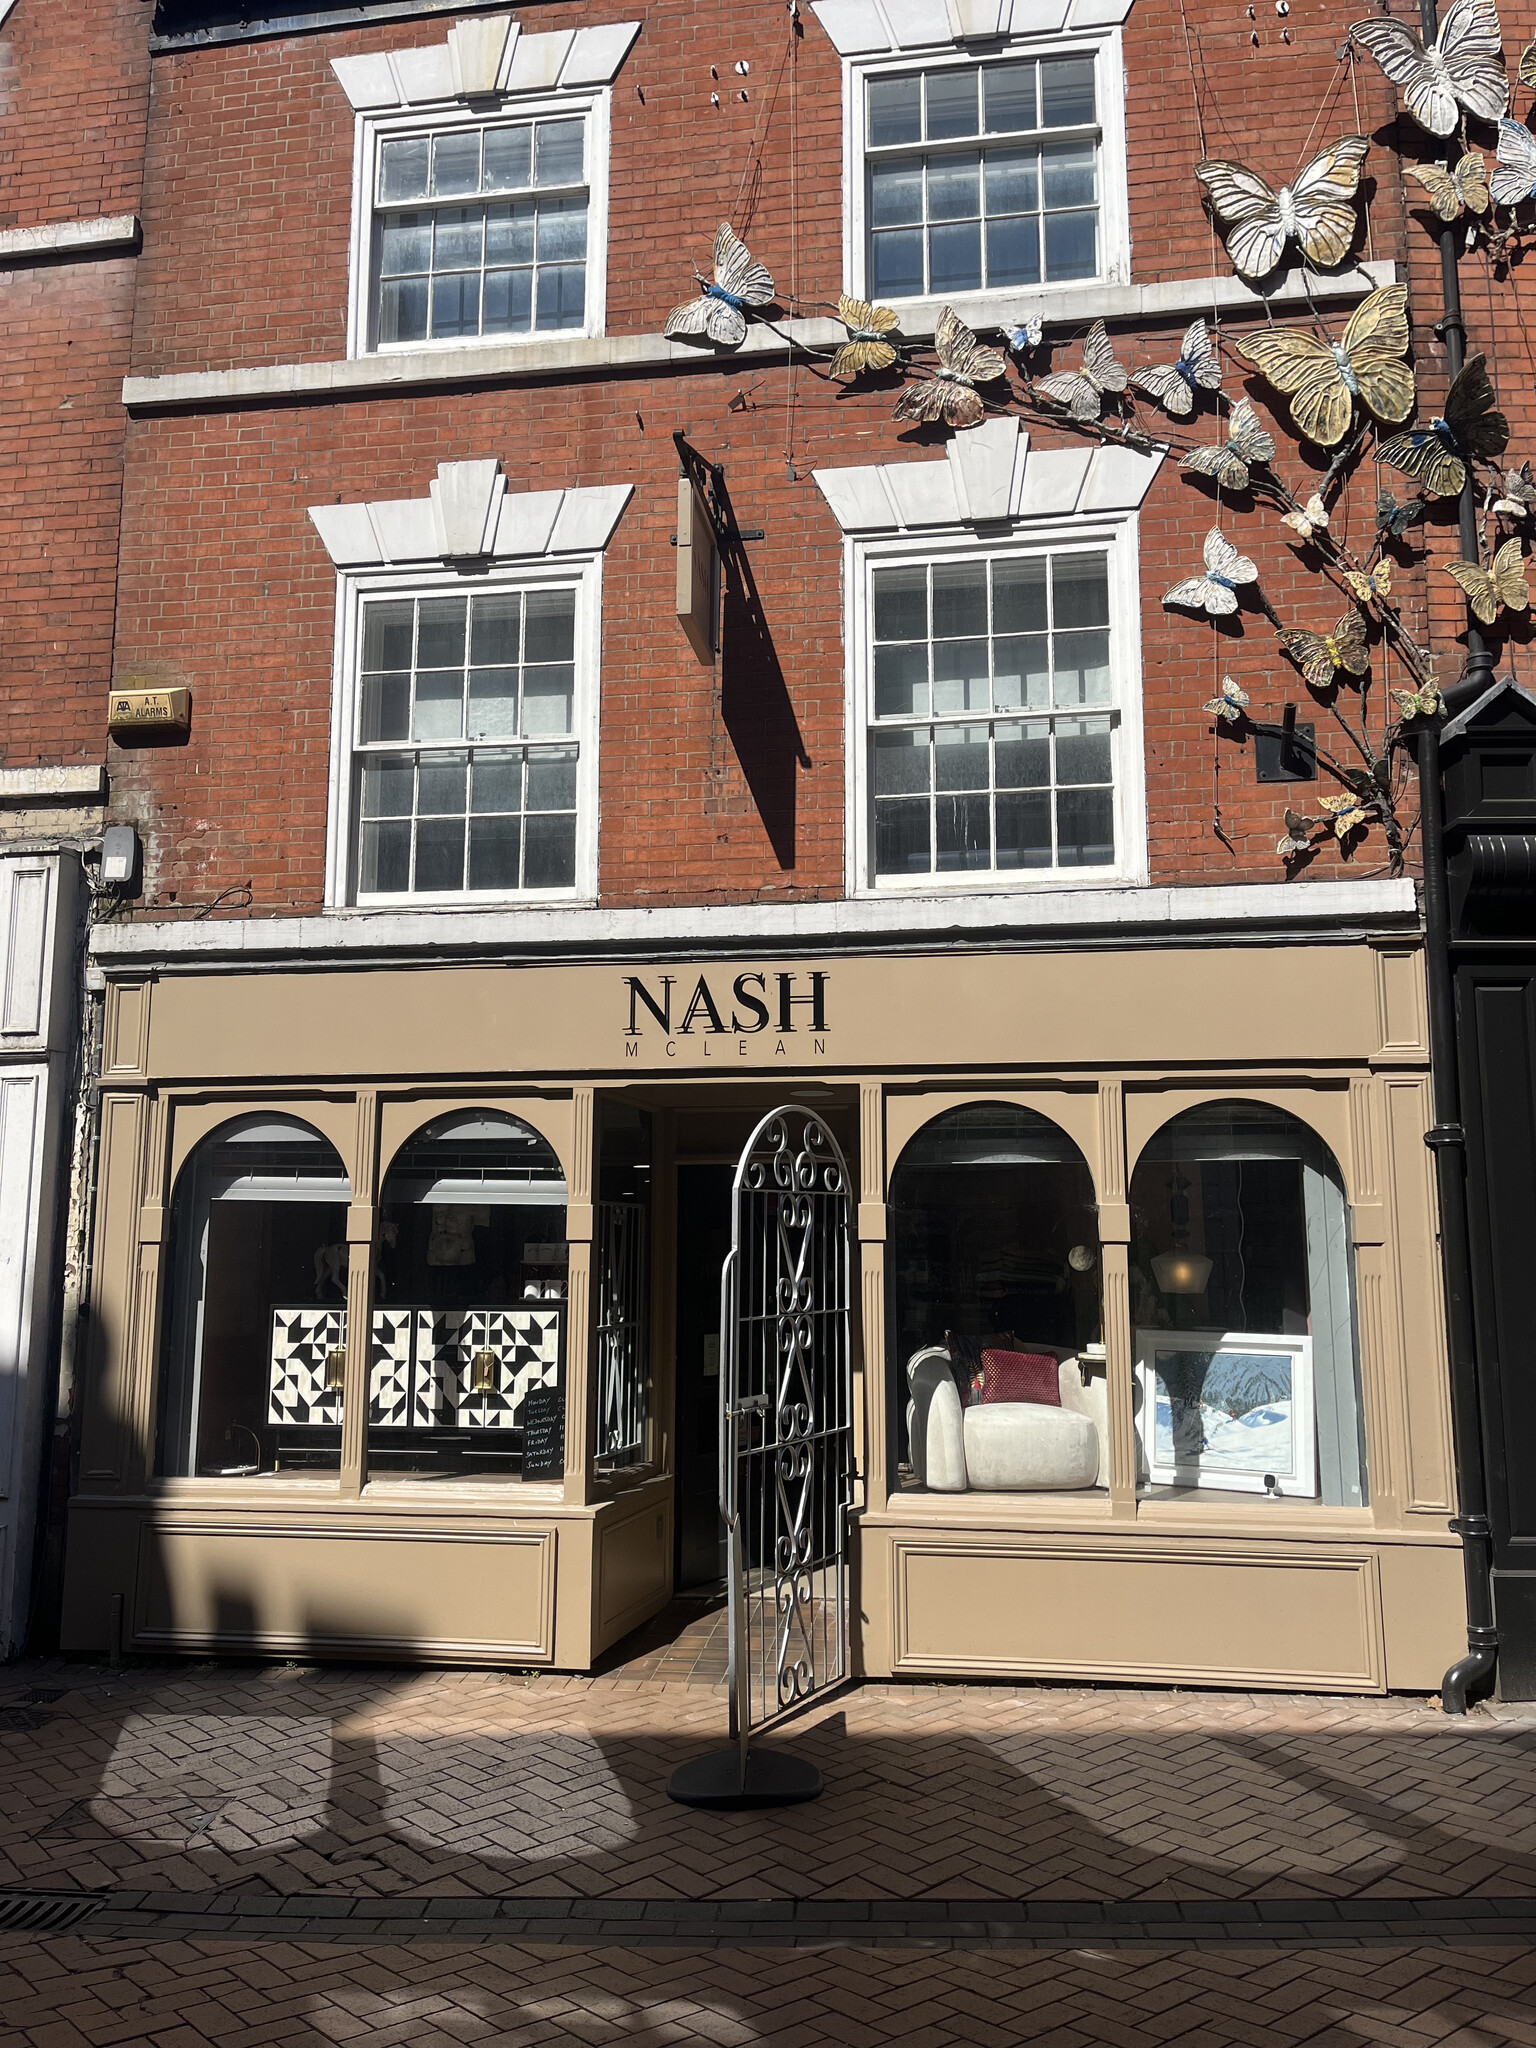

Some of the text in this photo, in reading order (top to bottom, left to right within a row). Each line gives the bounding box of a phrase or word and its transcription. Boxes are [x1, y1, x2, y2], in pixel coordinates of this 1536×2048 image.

[144, 696, 159, 706] A.T.
[135, 707, 168, 718] ALARMS
[621, 971, 831, 1036] NASH
[625, 1038, 825, 1057] MCLEAN
